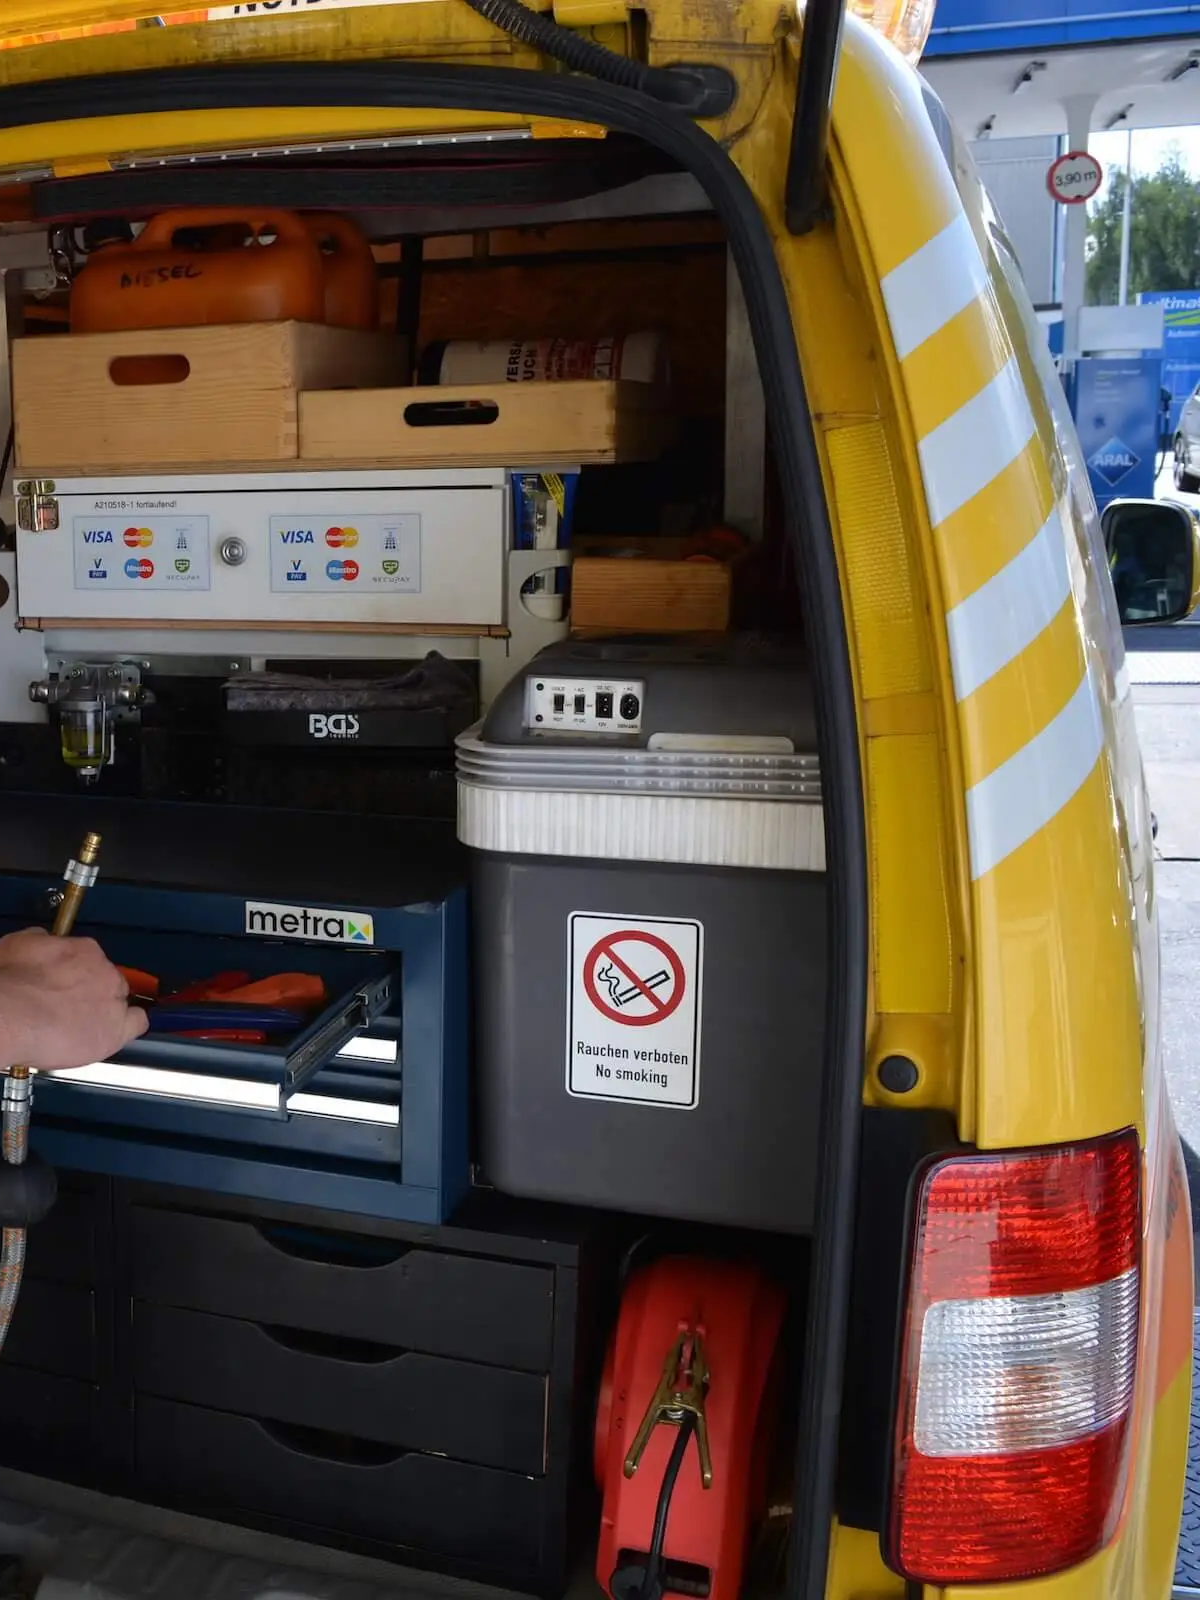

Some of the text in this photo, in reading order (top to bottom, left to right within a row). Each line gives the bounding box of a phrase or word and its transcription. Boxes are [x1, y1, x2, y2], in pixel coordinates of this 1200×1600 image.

[1055, 171, 1081, 188] 3,90
[1094, 453, 1134, 467] ARAL
[83, 530, 114, 544] VISA
[280, 530, 314, 544] VISA
[309, 713, 360, 738] BGS
[577, 1041, 688, 1066] Rauchen verboten
[596, 1063, 669, 1088] No smoking
